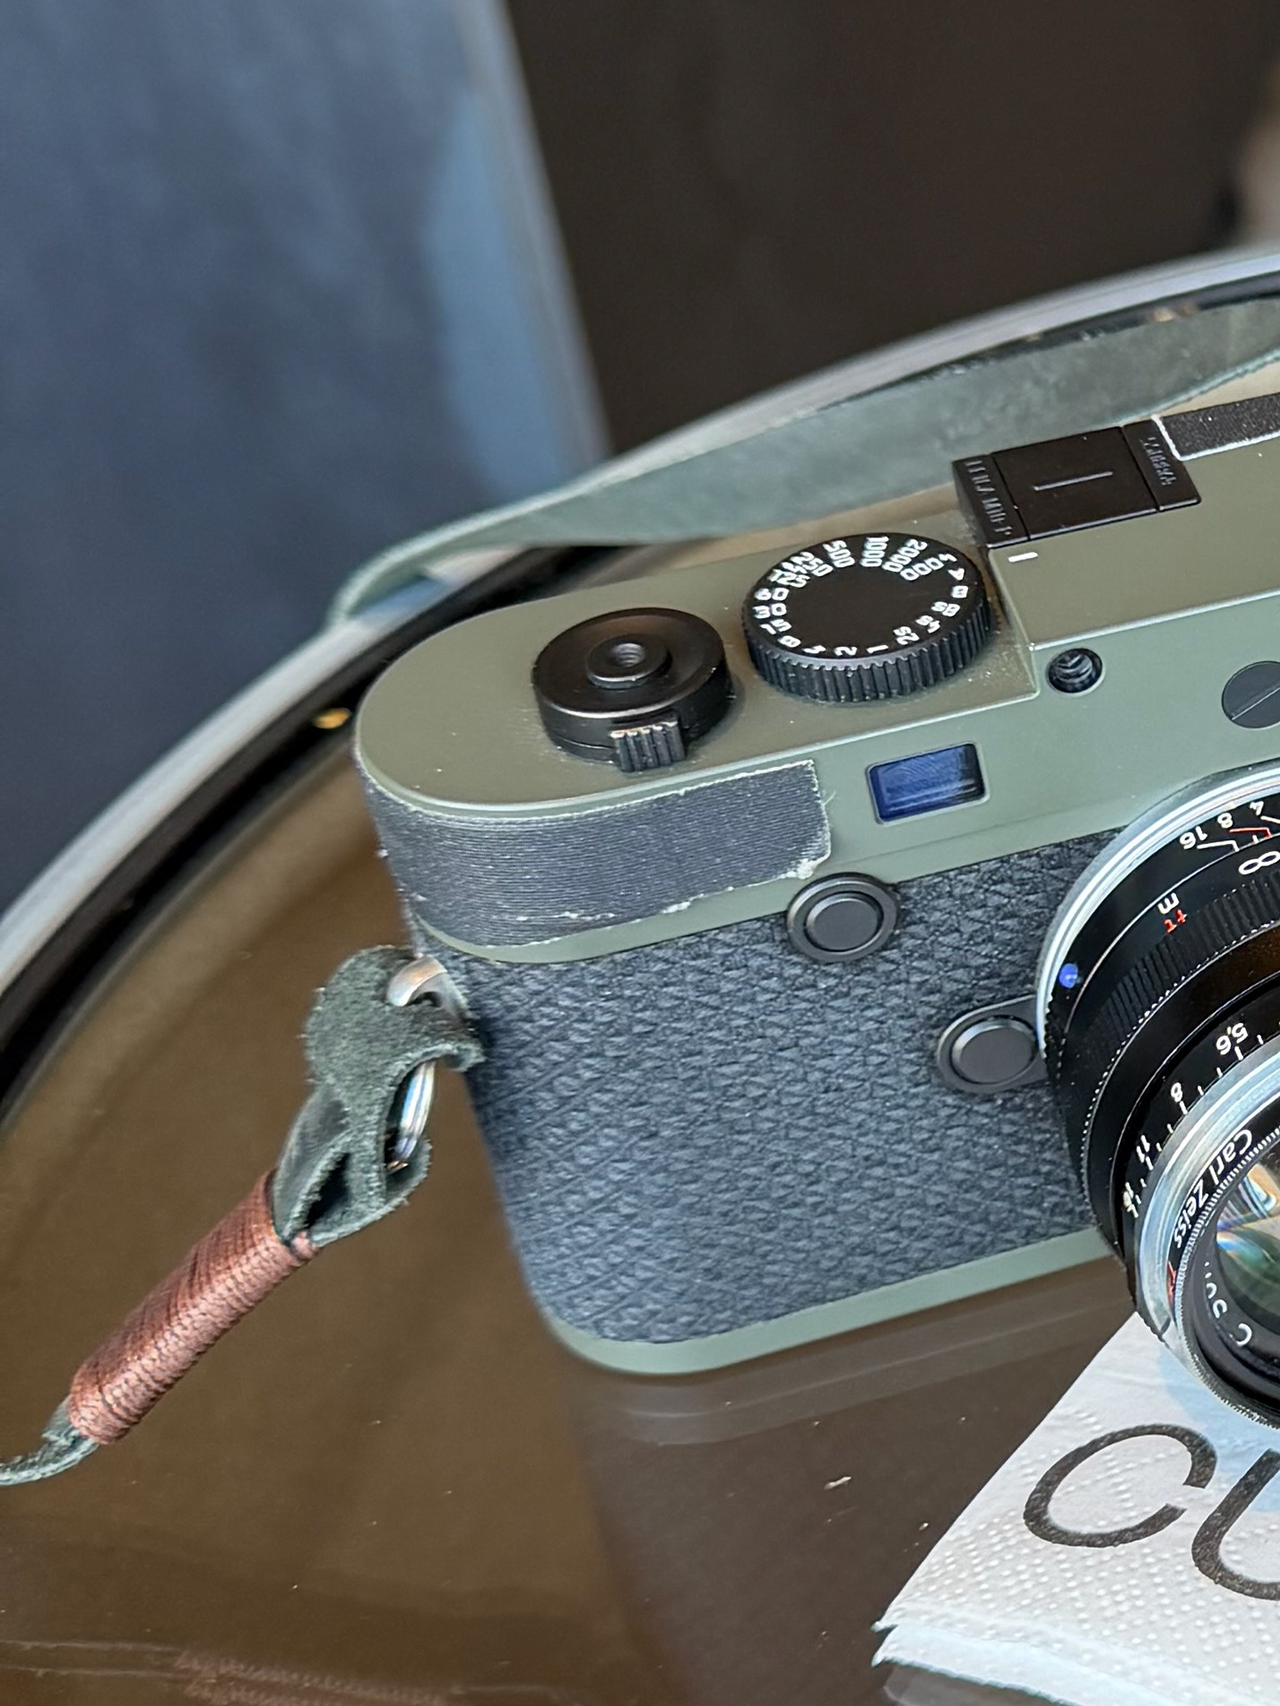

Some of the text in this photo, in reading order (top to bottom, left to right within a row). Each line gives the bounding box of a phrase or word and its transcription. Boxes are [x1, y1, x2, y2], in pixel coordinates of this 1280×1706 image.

[822, 539, 855, 568] 500
[860, 536, 889, 568] 1000
[882, 538, 928, 572] 2000
[900, 553, 957, 582] 4000
[754, 587, 789, 600] 60
[753, 603, 787, 618] 30
[760, 618, 792, 635] 15
[834, 646, 857, 656] 2
[866, 644, 889, 654] 1
[1217, 811, 1233, 829] 8
[1180, 824, 1207, 849] 16
[1157, 893, 1180, 914] m
[1216, 1023, 1248, 1056] 5,6
[1170, 1082, 1184, 1102] 8
[1172, 1129, 1253, 1249] Carl Zeiss
